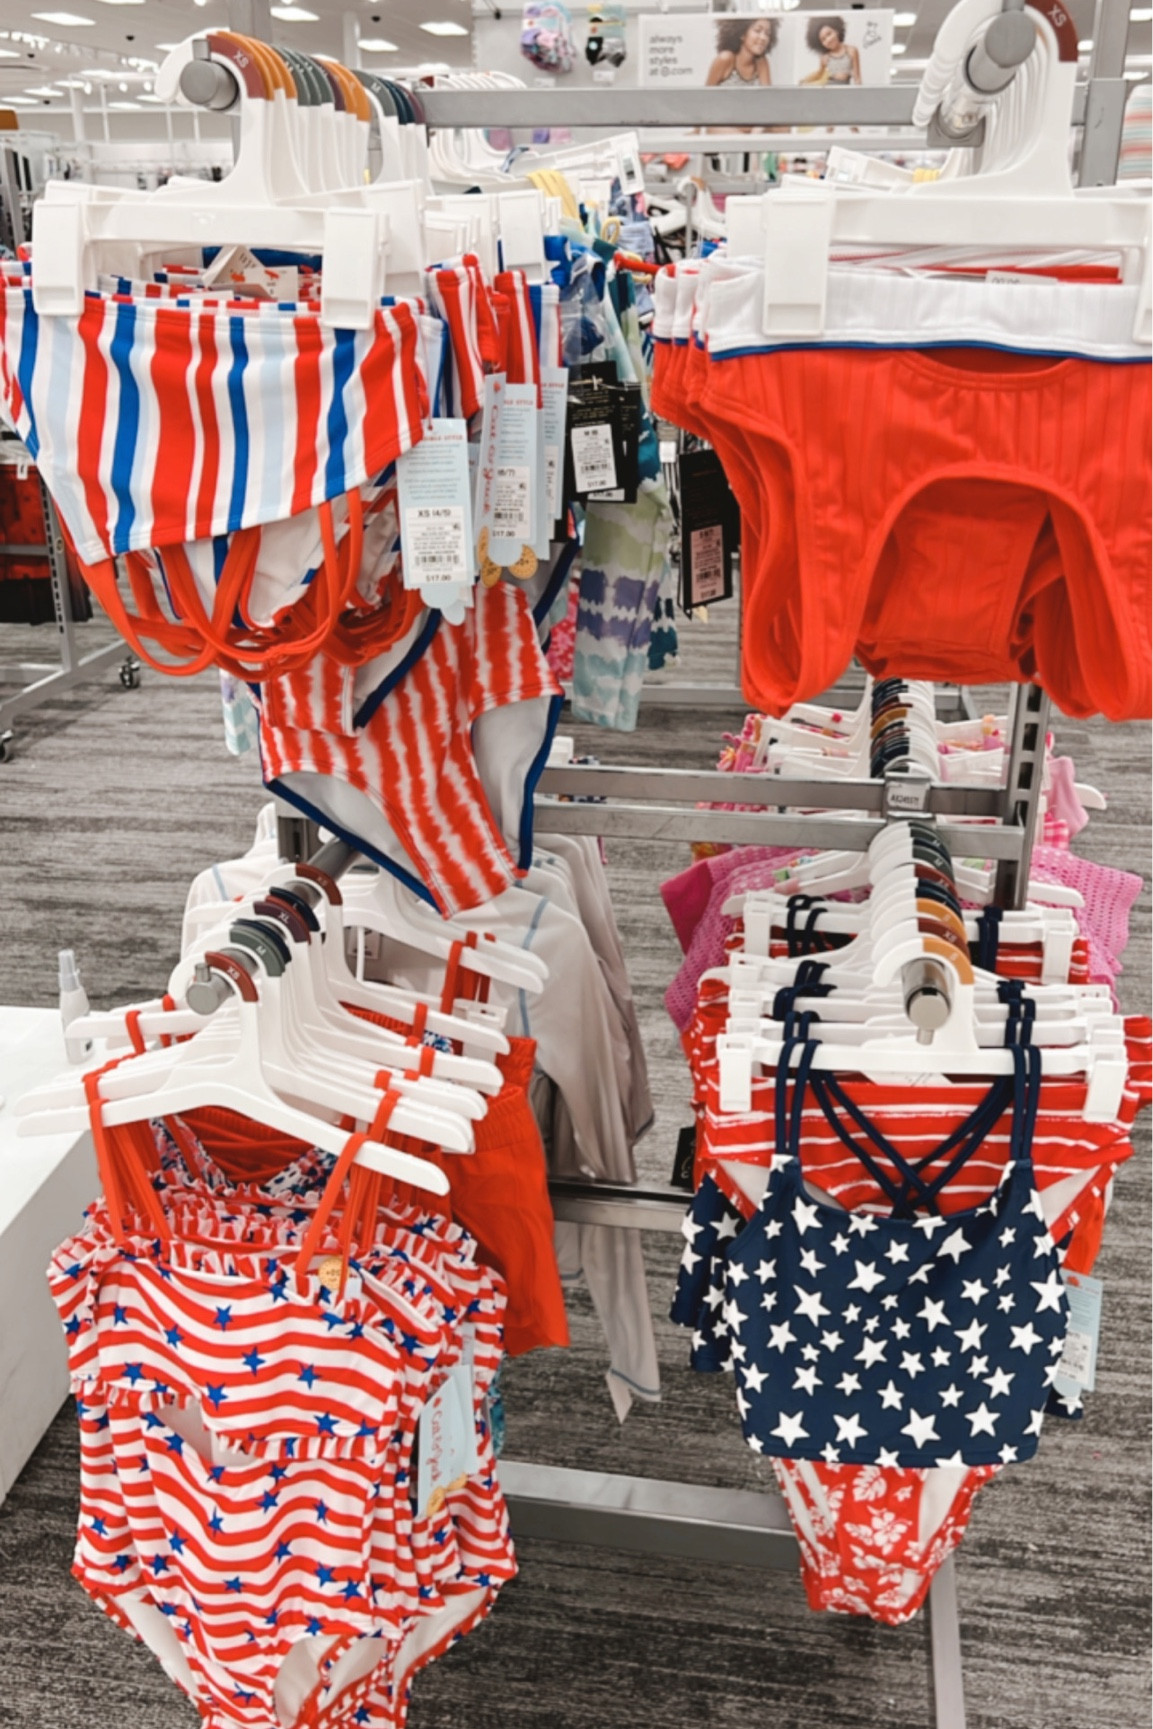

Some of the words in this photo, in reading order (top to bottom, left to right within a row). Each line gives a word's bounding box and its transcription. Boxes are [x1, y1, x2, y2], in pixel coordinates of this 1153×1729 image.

[1048, 4, 1067, 27] XS
[649, 35, 683, 45] always
[233, 49, 249, 68] XS
[649, 57, 678, 66] styles
[649, 68, 658, 76] at
[256, 945, 267, 955] M
[228, 967, 240, 980] XS
